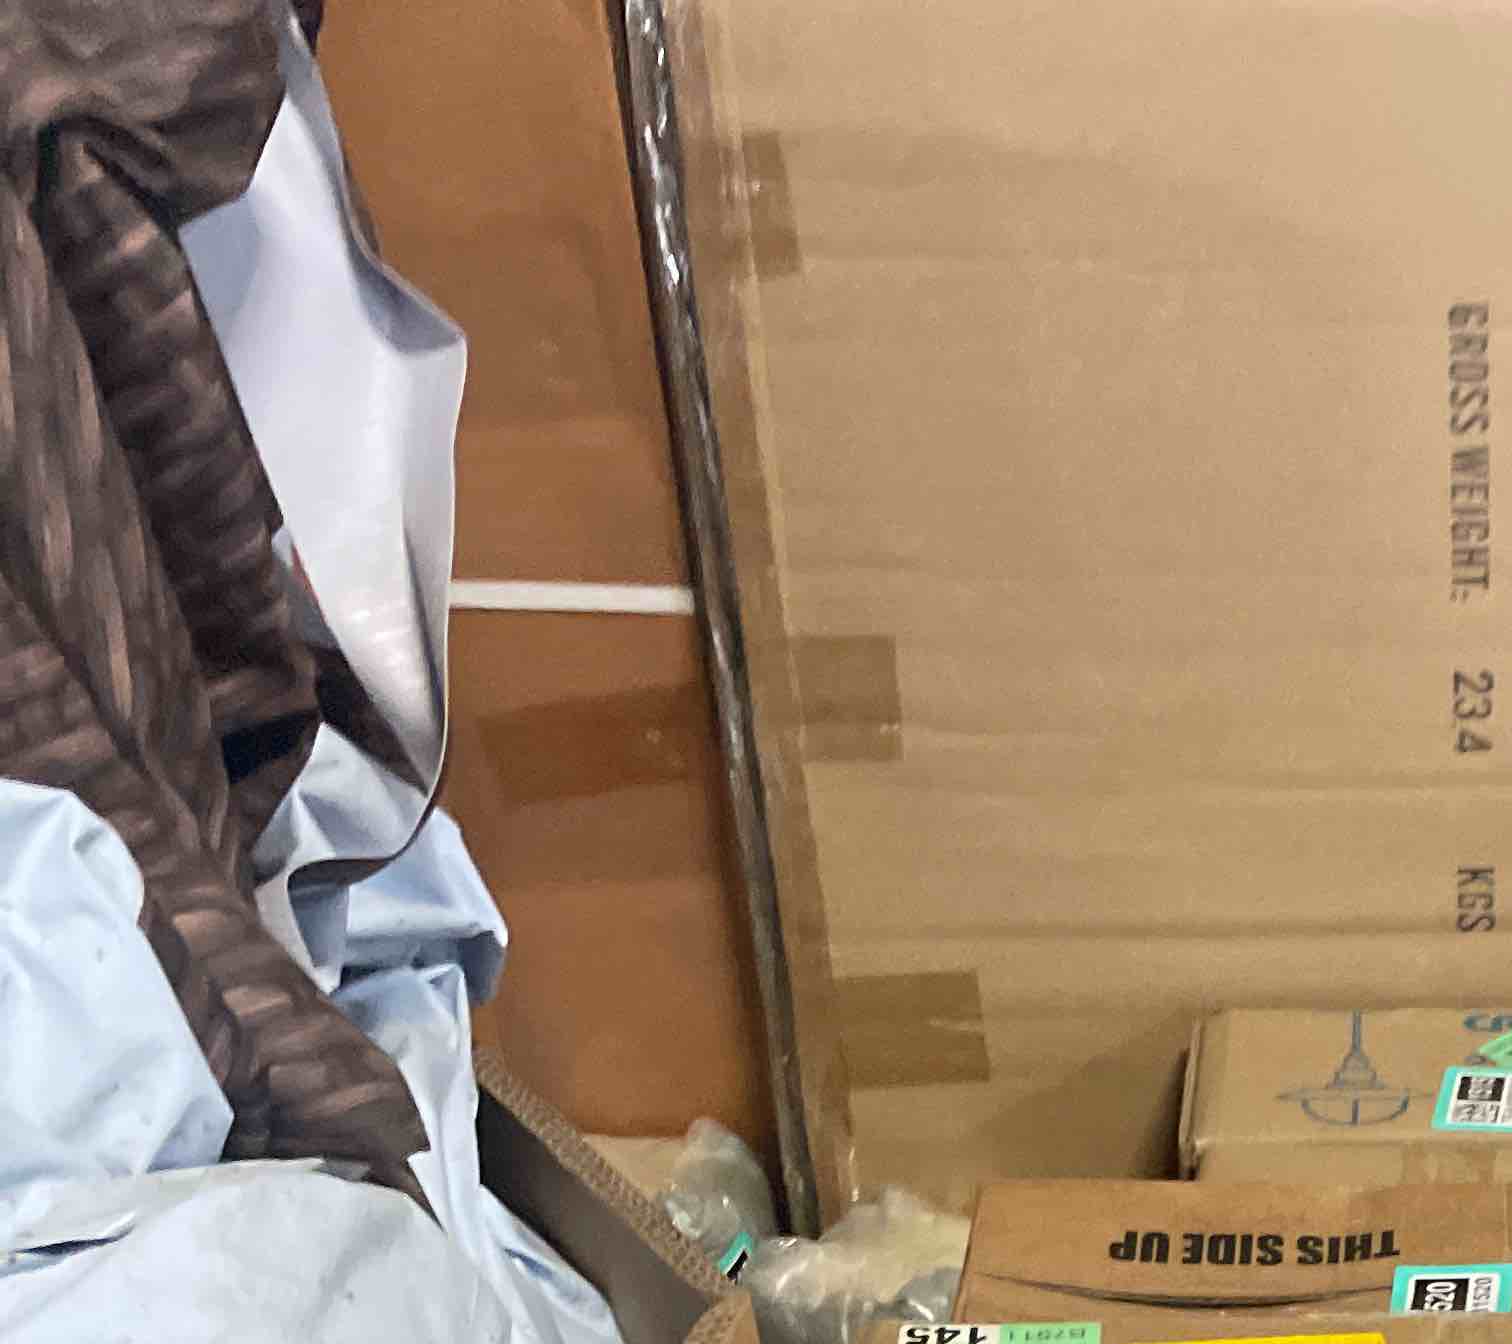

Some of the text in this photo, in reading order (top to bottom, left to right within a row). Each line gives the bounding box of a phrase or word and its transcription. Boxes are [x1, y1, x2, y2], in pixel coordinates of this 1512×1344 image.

[1448, 301, 1491, 435] GROSS
[1449, 444, 1491, 605] WEIGHT:
[1456, 864, 1495, 936] KGS
[1107, 1228, 1402, 1268] THIS SIDE UP
